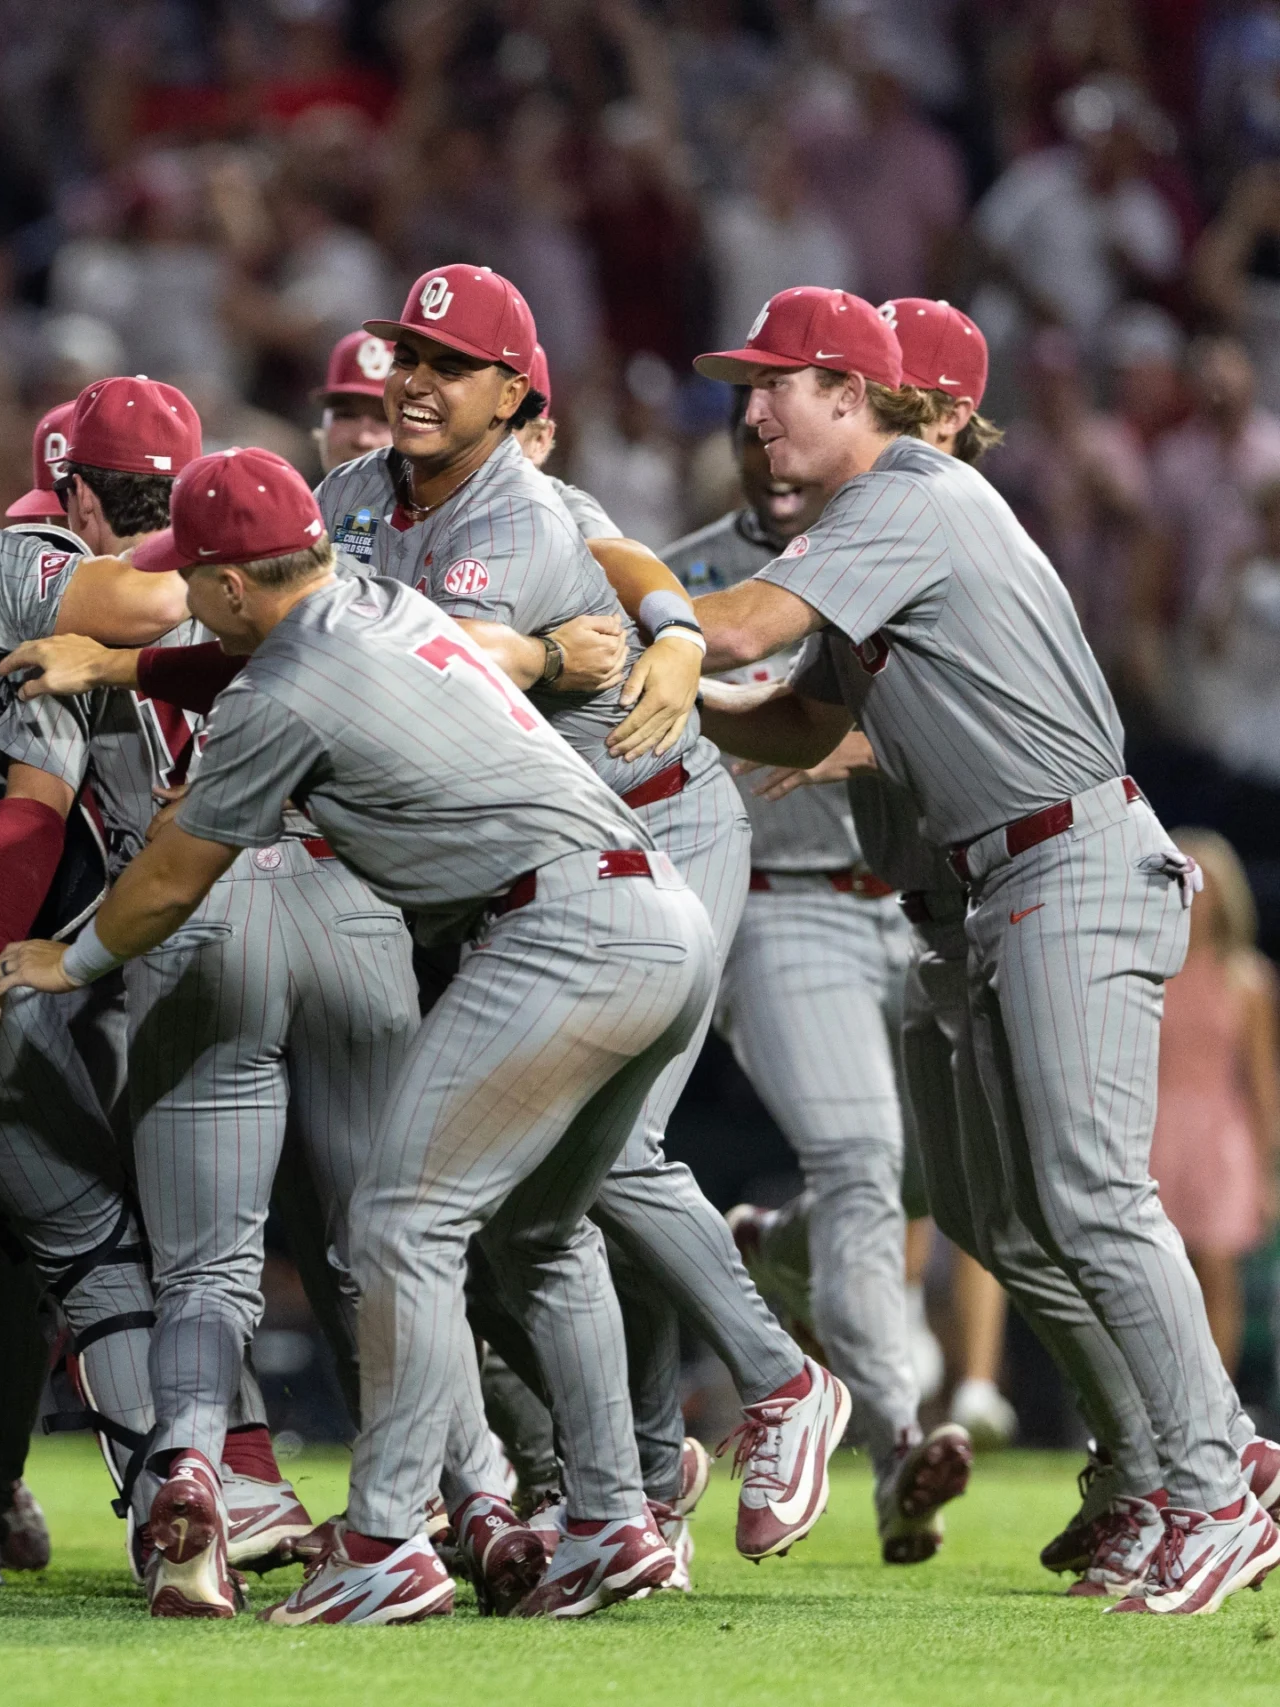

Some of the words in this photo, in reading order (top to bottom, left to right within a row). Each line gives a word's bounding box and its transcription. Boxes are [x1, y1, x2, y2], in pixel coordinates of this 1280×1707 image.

[419, 276, 454, 321] OU
[876, 304, 898, 330] O
[343, 534, 372, 546] COLLEGE
[448, 559, 488, 595] SEC
